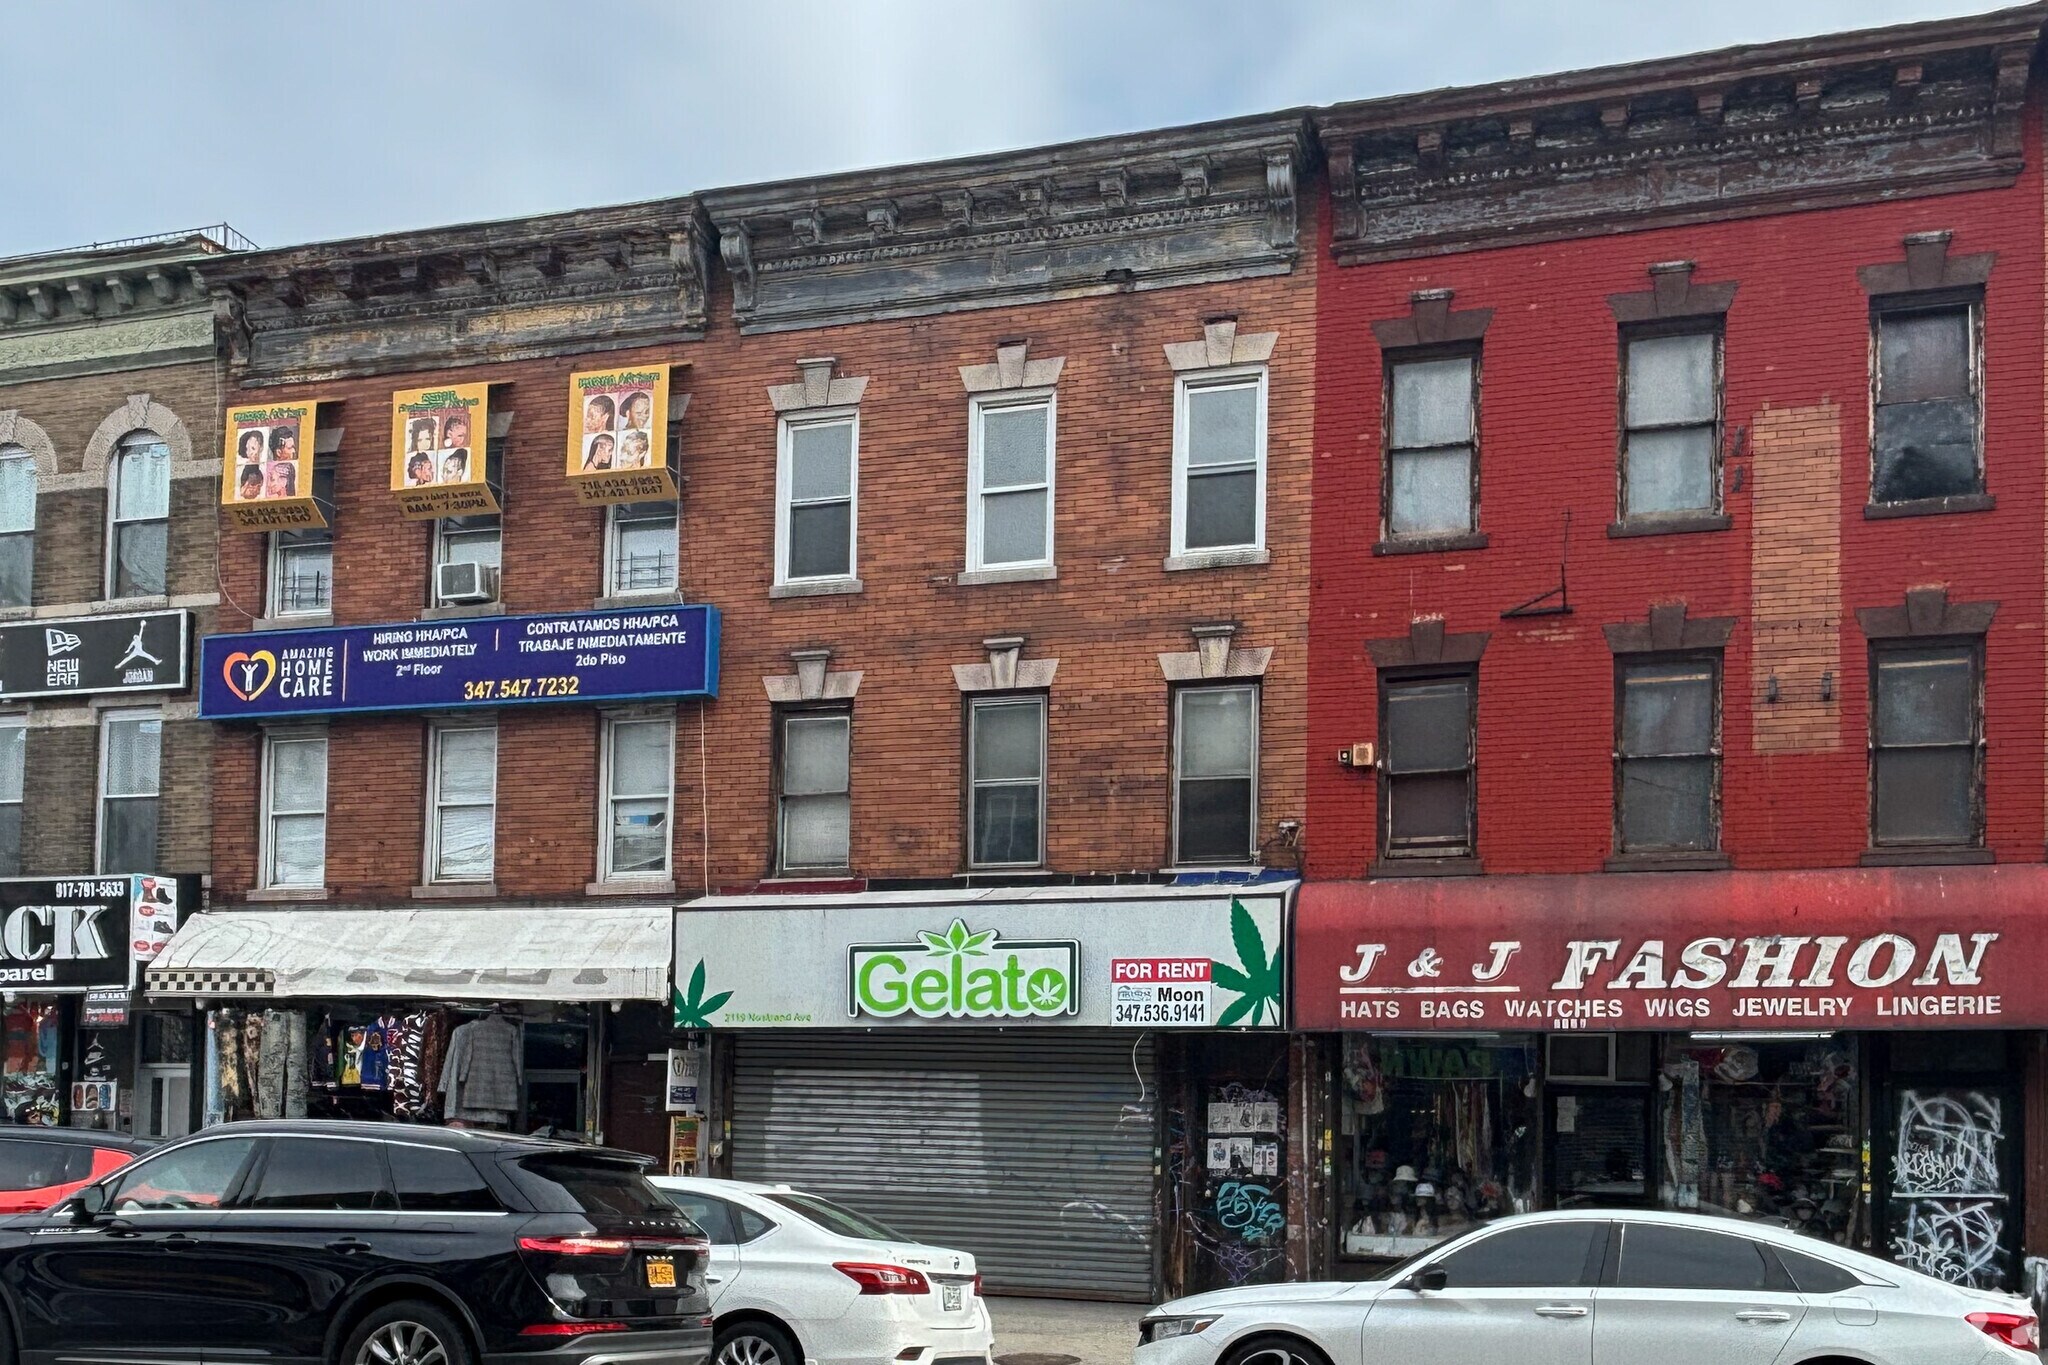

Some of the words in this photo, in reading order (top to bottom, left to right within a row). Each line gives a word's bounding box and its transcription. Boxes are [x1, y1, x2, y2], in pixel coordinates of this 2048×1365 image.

[526, 620, 621, 636] CONTRATAMOS
[623, 614, 679, 630] HHA/PCA
[373, 631, 413, 645] HIRING
[415, 627, 468, 642] HHA/PCA
[518, 638, 575, 653] TRABAJE
[577, 631, 687, 649] INMEDIATAMENTE
[281, 647, 334, 660] AMAZING
[363, 648, 399, 662] WORK
[401, 643, 477, 660] IMMEDIATELY
[575, 654, 598, 667] 2do
[600, 652, 626, 666] Piso
[47, 659, 79, 672] NEW
[281, 658, 334, 677] HOME
[395, 664, 412, 677] 2nd
[413, 663, 443, 676] Floor
[47, 672, 79, 687] ERA
[279, 675, 333, 698] CARE
[463, 676, 580, 700] 347.547.7232
[55, 881, 125, 898] 917-791-5633
[0, 905, 109, 961] CK
[1115, 963, 1152, 979] FOR
[1158, 962, 1208, 979] RENT
[1340, 944, 1387, 983] J
[1407, 948, 1443, 978] &
[1472, 941, 1521, 983] J
[1551, 932, 1999, 990] FASHION
[859, 953, 1068, 1013] Gelato
[1158, 987, 1204, 1002] Moon
[1115, 1003, 1205, 1022] 347.536.9141
[1340, 1001, 1400, 1019] HATS
[1420, 1001, 1485, 1019] BAGS
[1504, 1000, 1623, 1019] WATCHES
[1644, 998, 1710, 1018] WIGS
[1732, 997, 1853, 1018] JEWELRY
[1877, 995, 2001, 1016] LINGERIE
[748, 1012, 792, 1022] Nostrand
[793, 1012, 812, 1022] Ave
